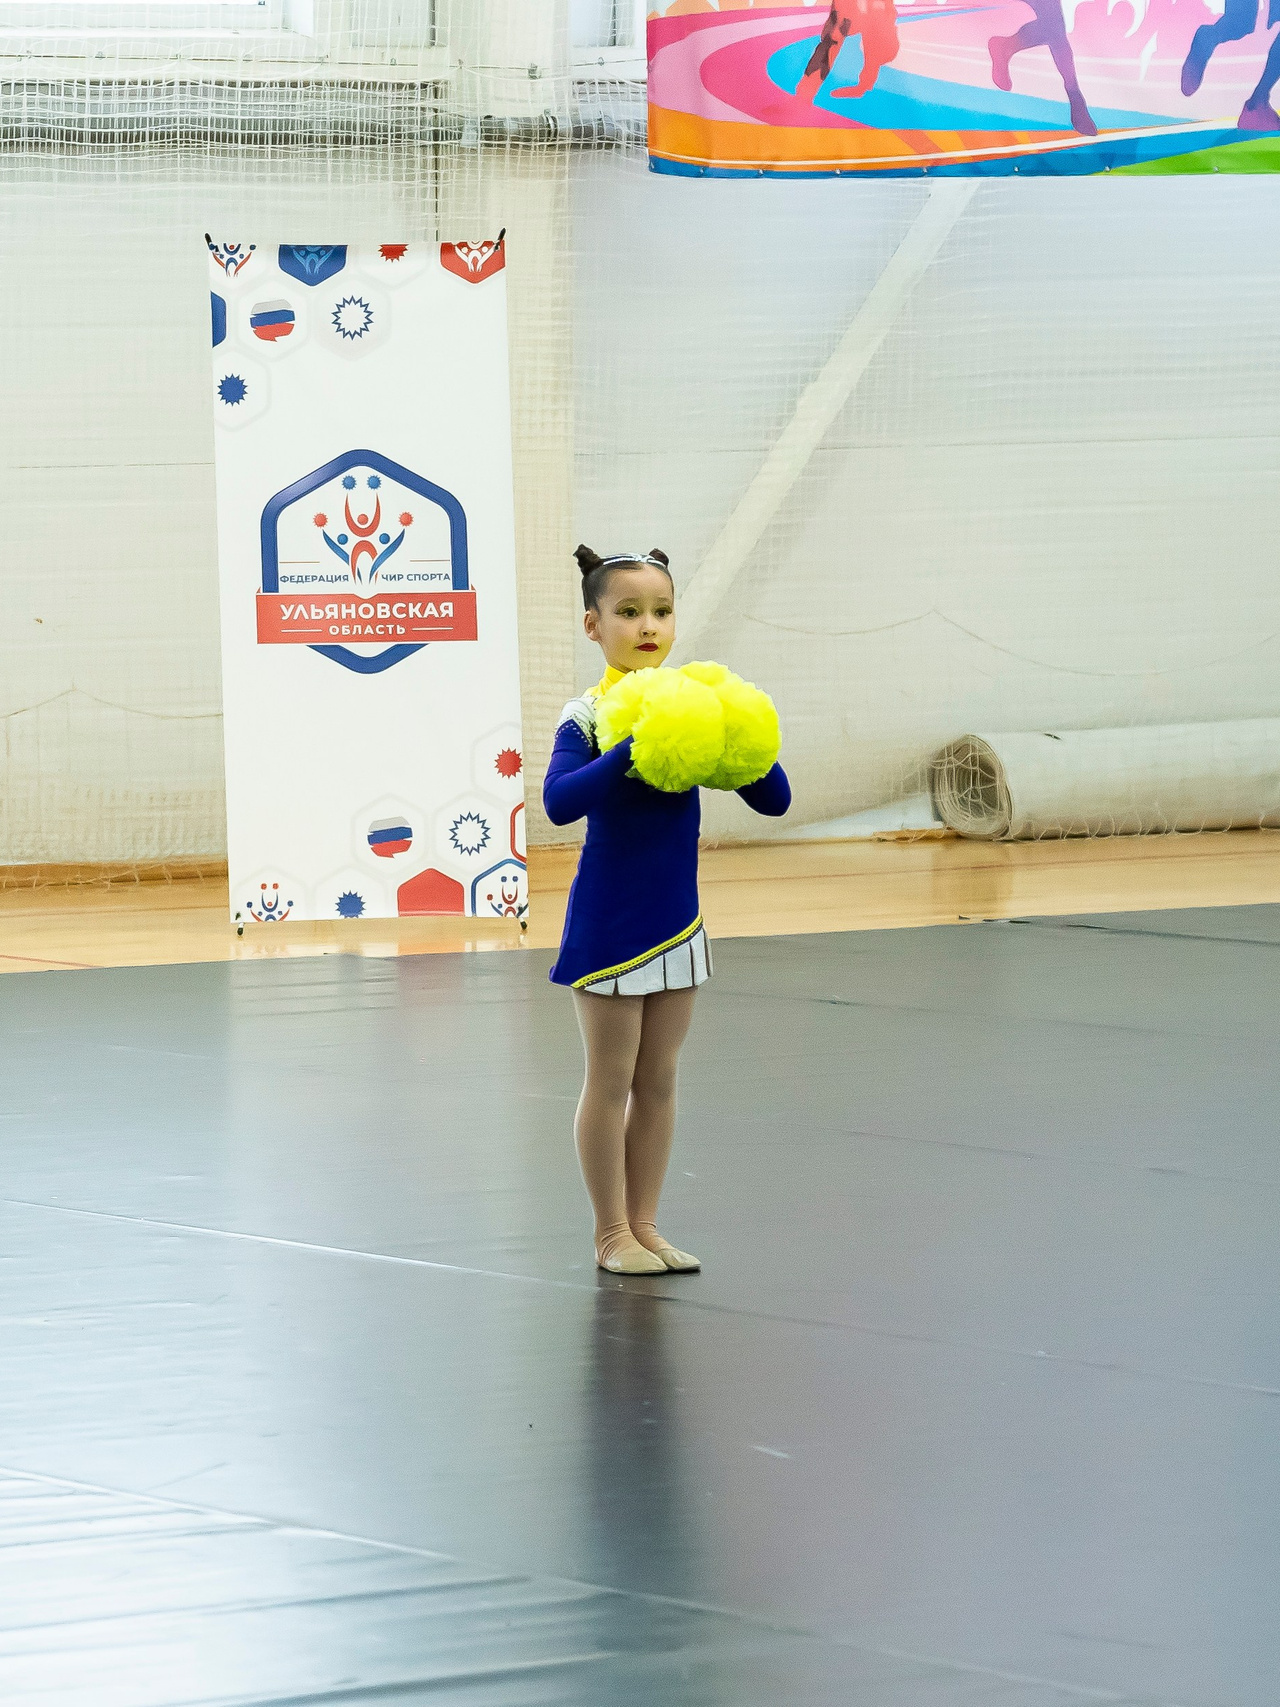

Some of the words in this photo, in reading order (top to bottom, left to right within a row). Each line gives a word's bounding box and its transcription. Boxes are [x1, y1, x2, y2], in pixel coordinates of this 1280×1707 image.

[280, 574, 349, 584] ФЕДЕРАЦИЯ
[381, 573, 404, 582] ЧИР
[406, 573, 451, 582] СПОРТА
[280, 601, 454, 621] УЛЬЯНОВСКАЯ
[329, 624, 406, 636] ОБЛАСТЬ
